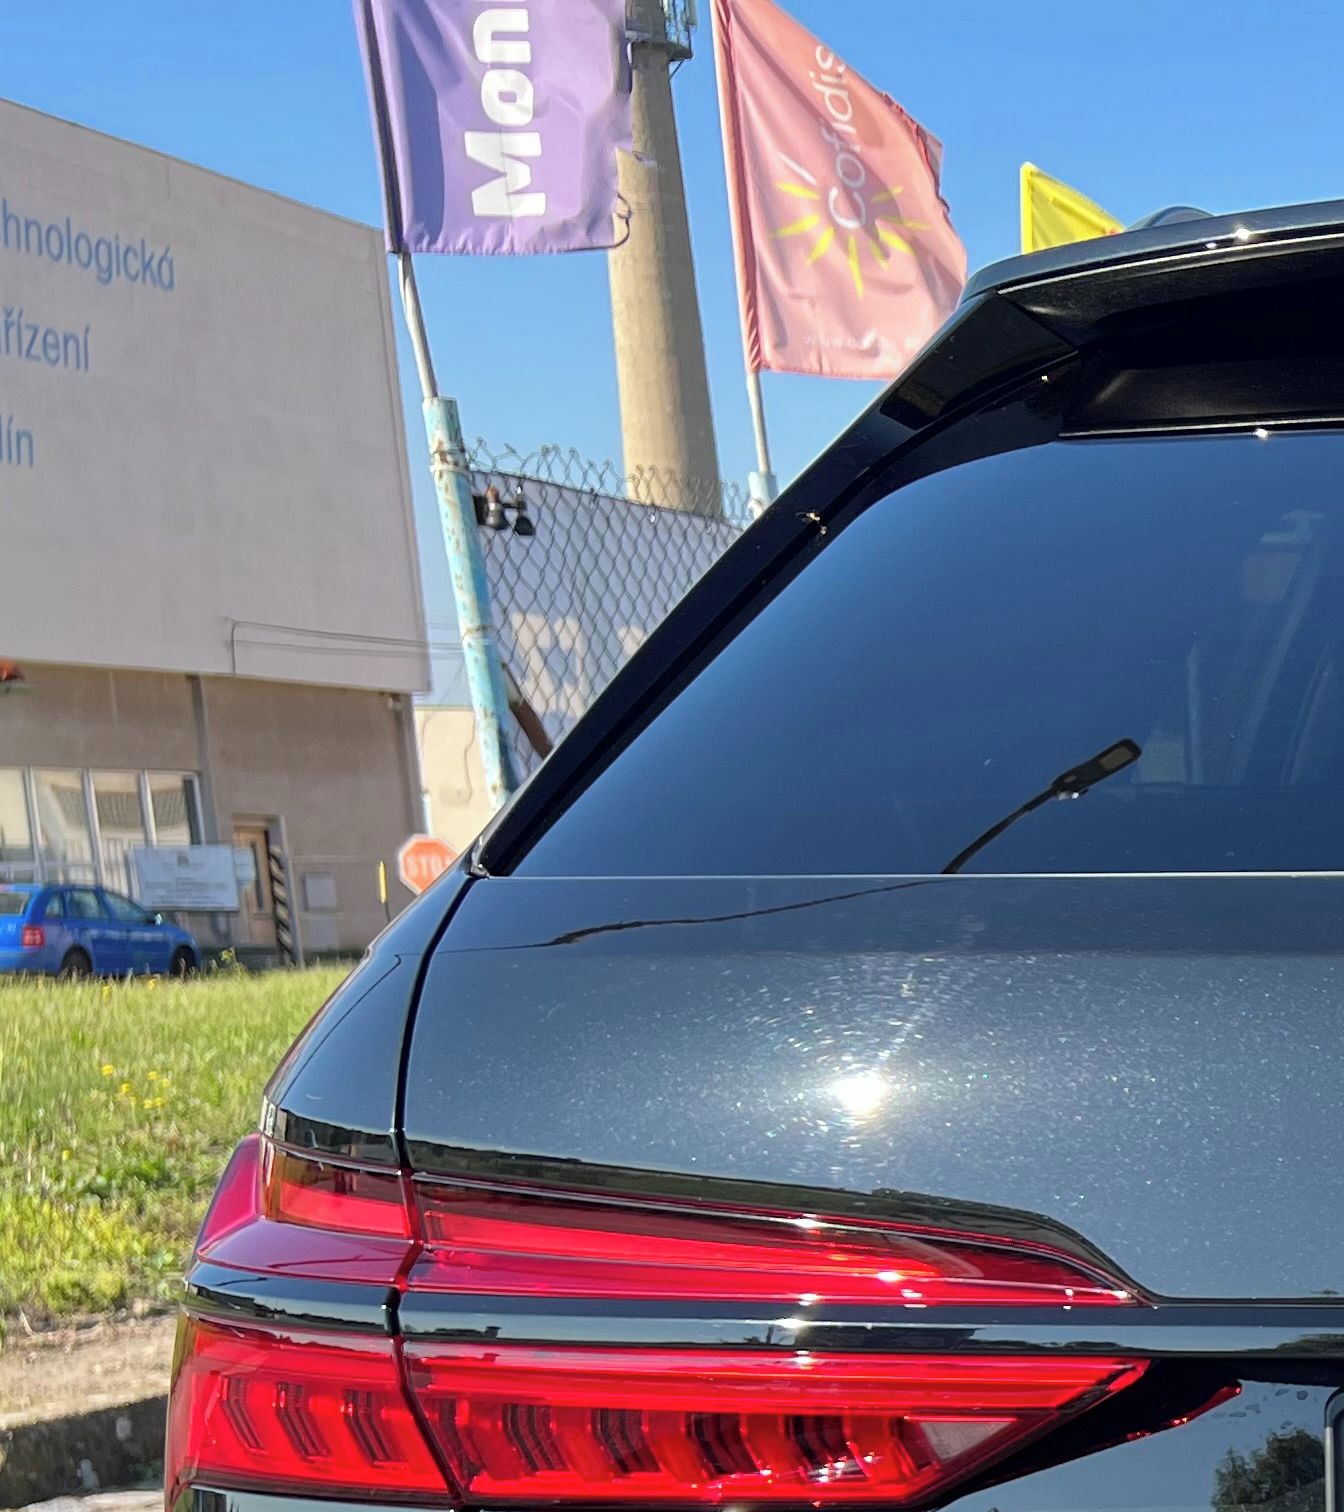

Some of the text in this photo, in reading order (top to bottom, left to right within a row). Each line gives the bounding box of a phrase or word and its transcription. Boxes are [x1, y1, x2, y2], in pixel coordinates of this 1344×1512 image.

[464, 0, 547, 218] Mon
[808, 44, 868, 230] Cofidis
[1, 198, 175, 291] hnologická
